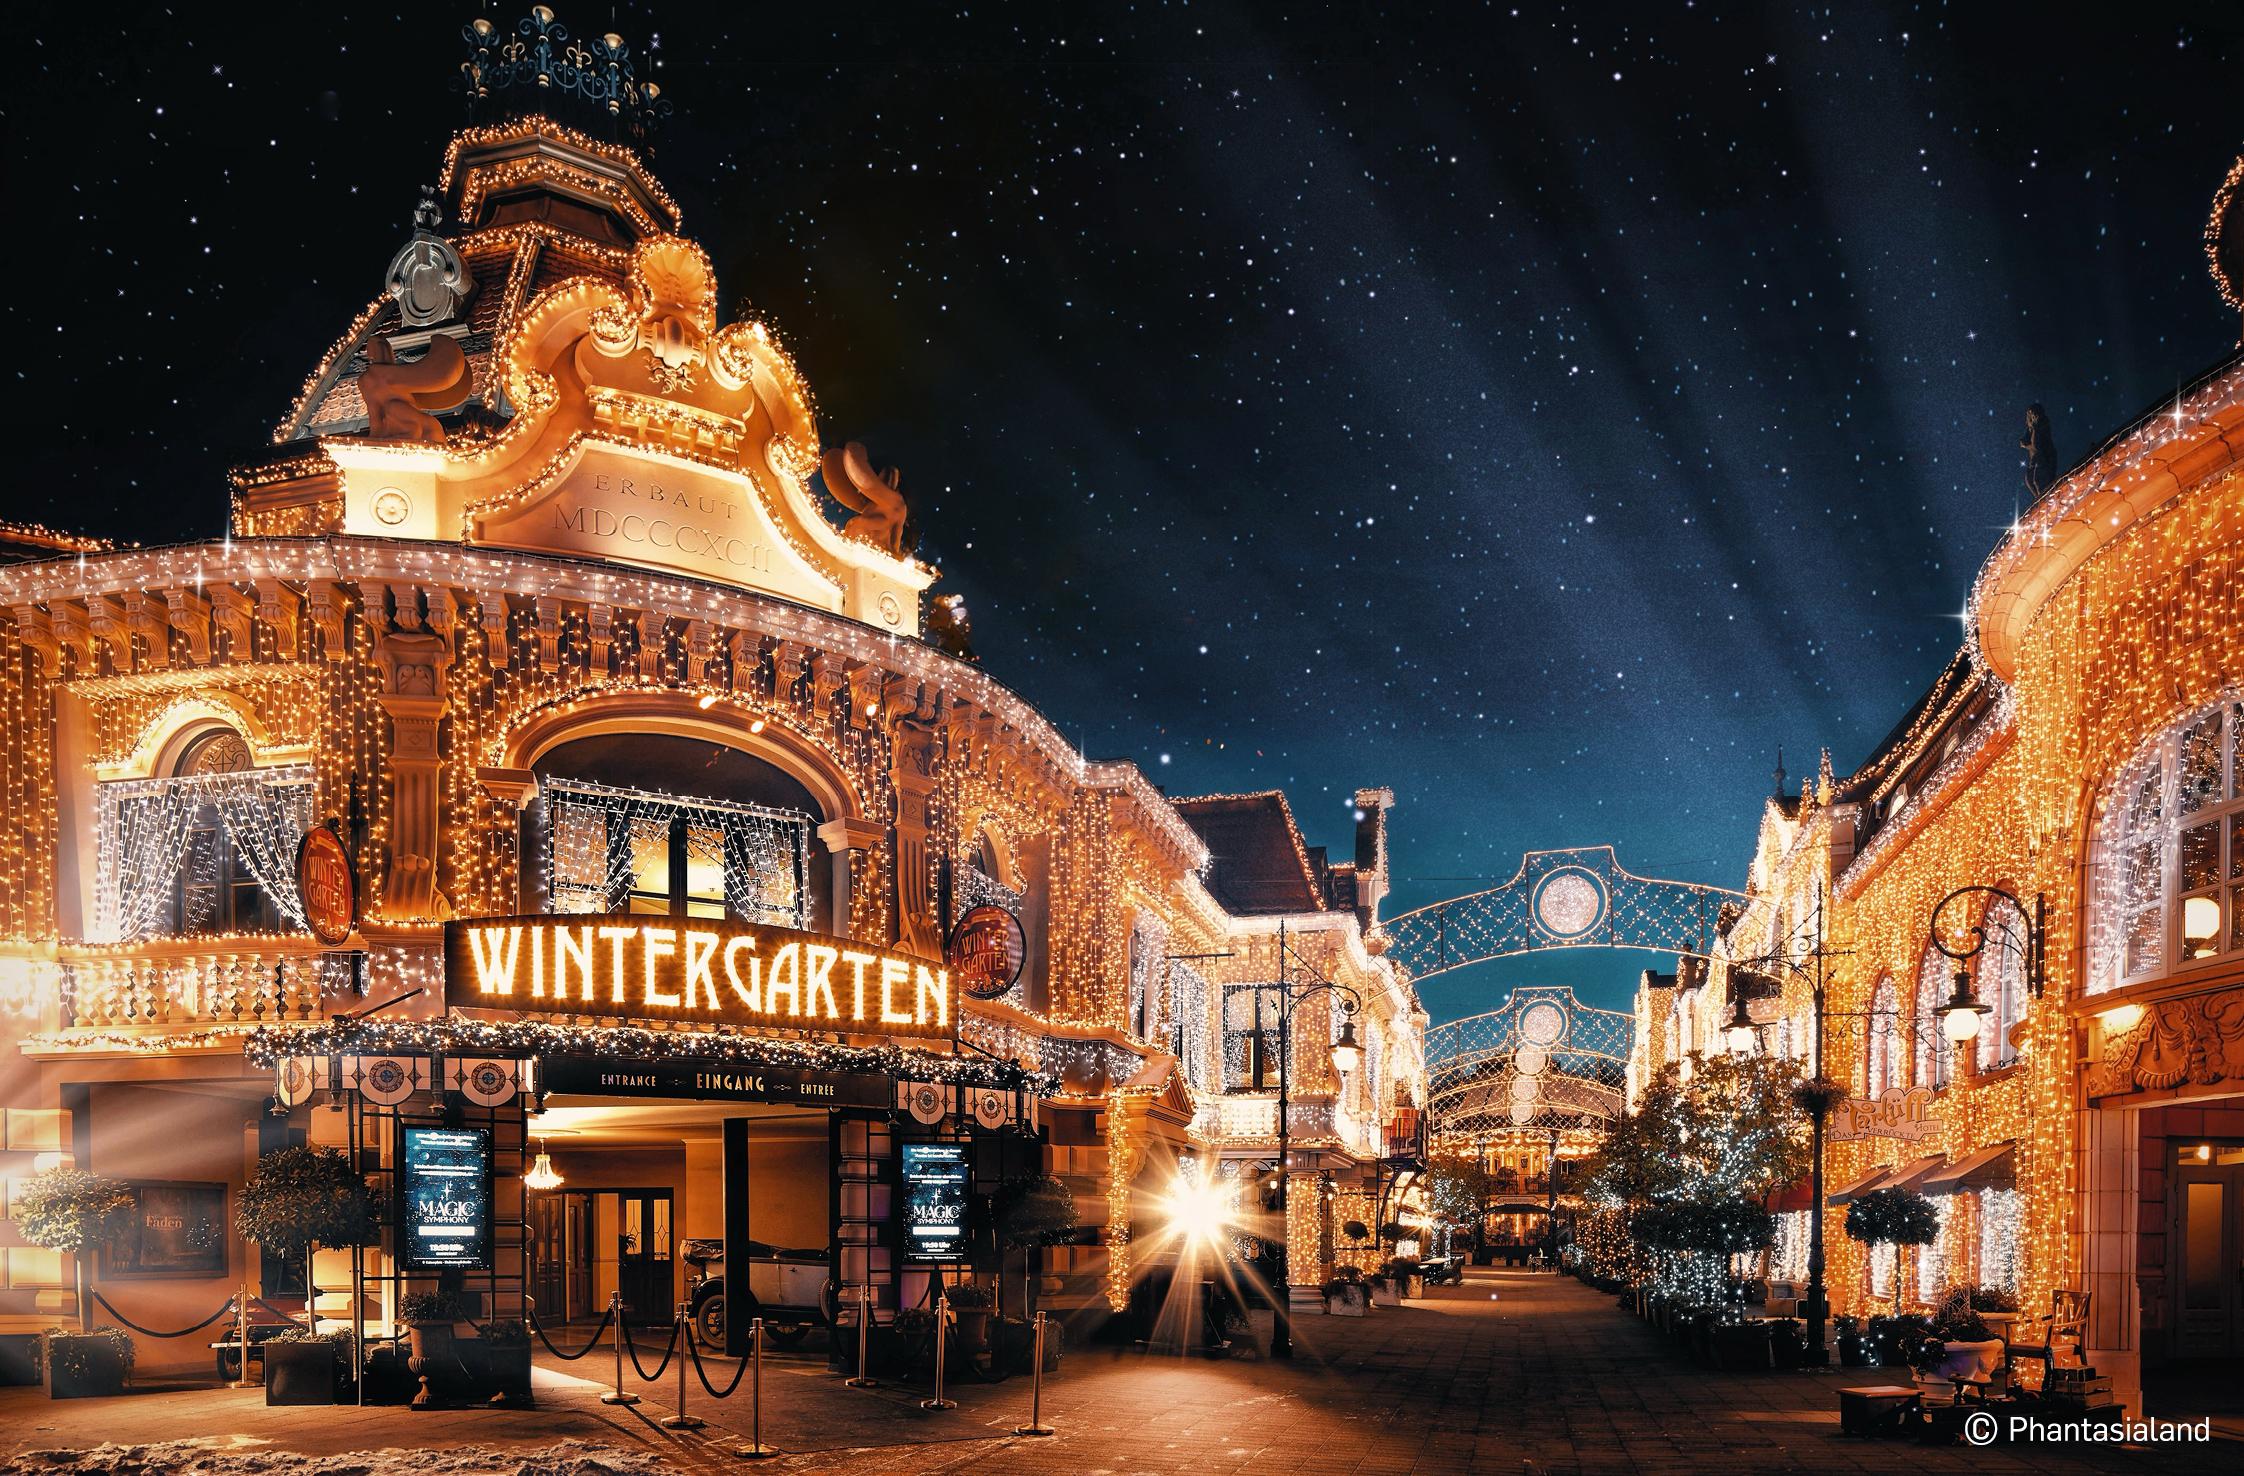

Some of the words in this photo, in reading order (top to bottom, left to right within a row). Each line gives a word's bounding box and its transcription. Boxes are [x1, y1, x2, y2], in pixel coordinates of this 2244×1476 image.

[595, 474, 738, 519] ERBAUT
[553, 503, 774, 573] MDCCCXCII
[308, 856, 345, 896] WINTER
[308, 883, 346, 917] GARTEN
[962, 929, 1010, 955] WINTER
[962, 951, 1011, 974] GARTEN
[467, 925, 949, 1027] WINTERGARTEN
[601, 1074, 656, 1087] ENTRANCE
[696, 1073, 765, 1092] EINGANG
[800, 1083, 834, 1096] ENTRÉE
[418, 1200, 475, 1217] MAGIC
[424, 1216, 470, 1224] SYMPHONY
[913, 1205, 960, 1219] MAGIC
